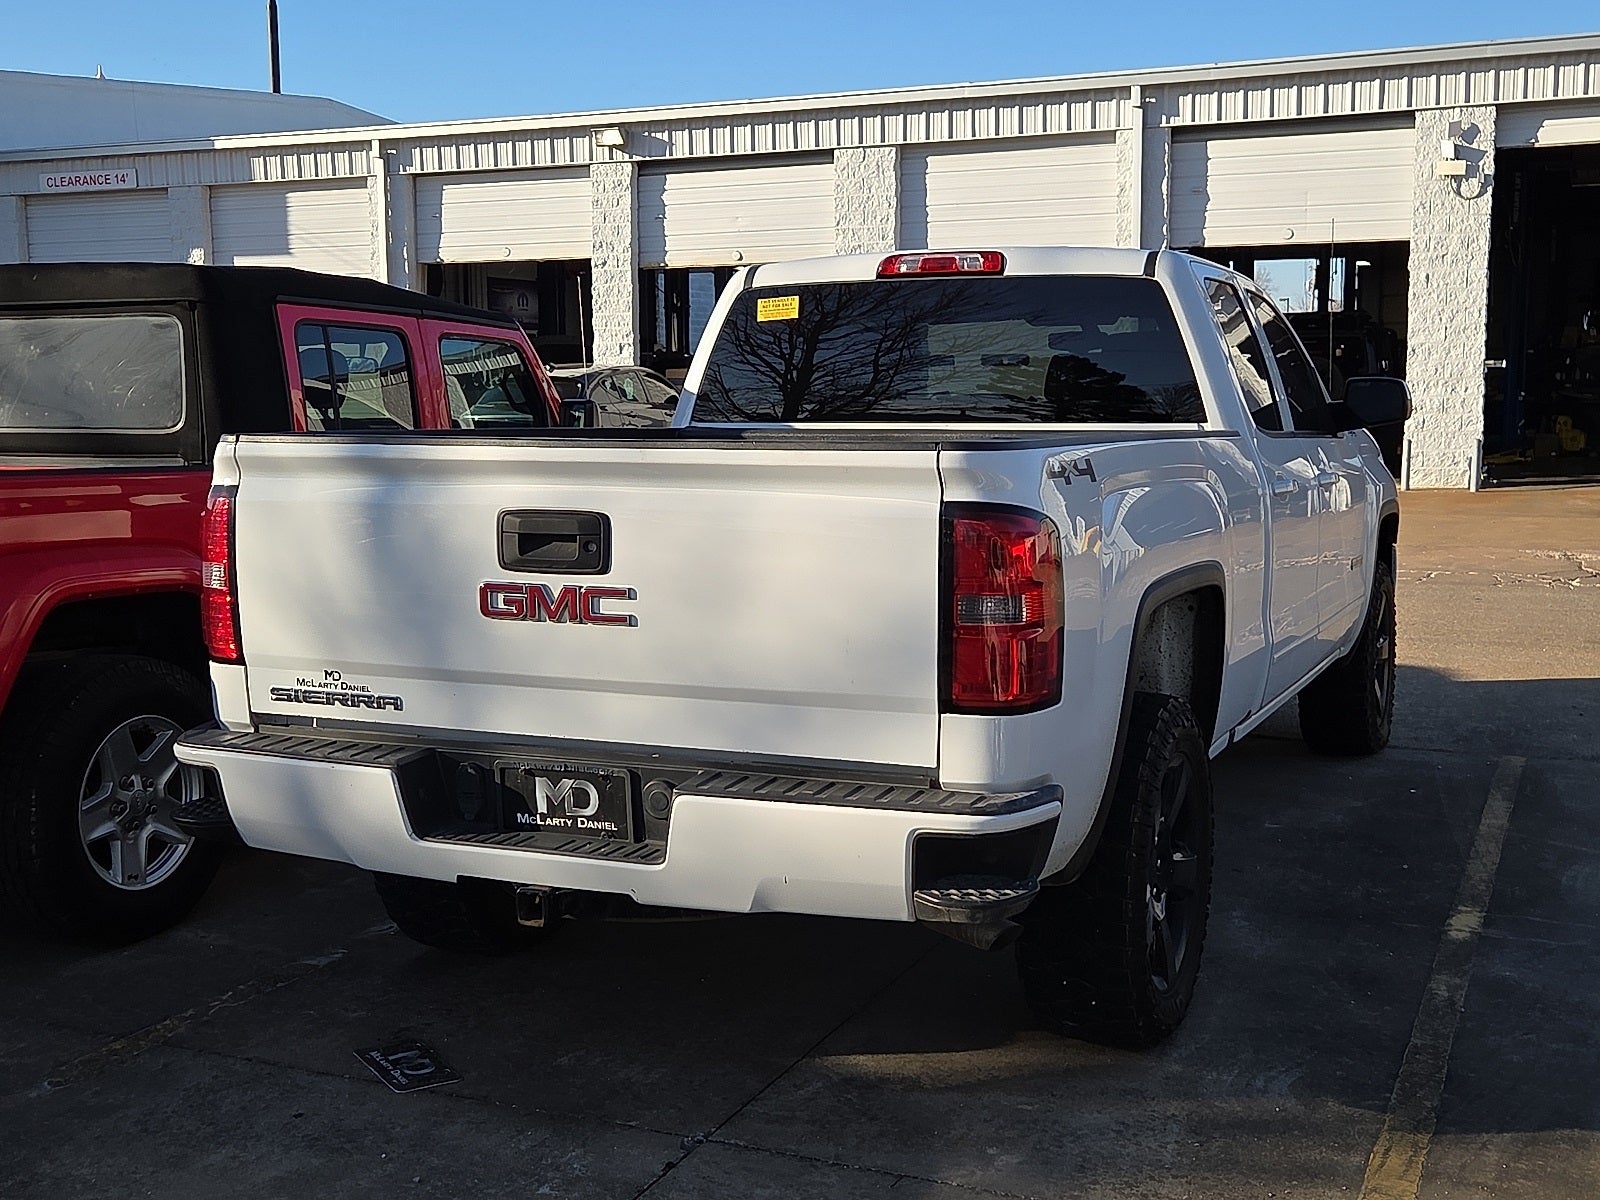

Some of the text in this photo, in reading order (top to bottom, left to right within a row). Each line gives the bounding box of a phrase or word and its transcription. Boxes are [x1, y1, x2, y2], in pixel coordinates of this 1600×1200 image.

[46, 173, 129, 188] CLEARANCE 14'
[479, 582, 638, 627] GMC
[323, 669, 342, 682] MD
[340, 681, 371, 693] DANIEL
[269, 686, 404, 712] SIERRA
[534, 776, 599, 817] MD
[577, 817, 618, 831] DANIEL
